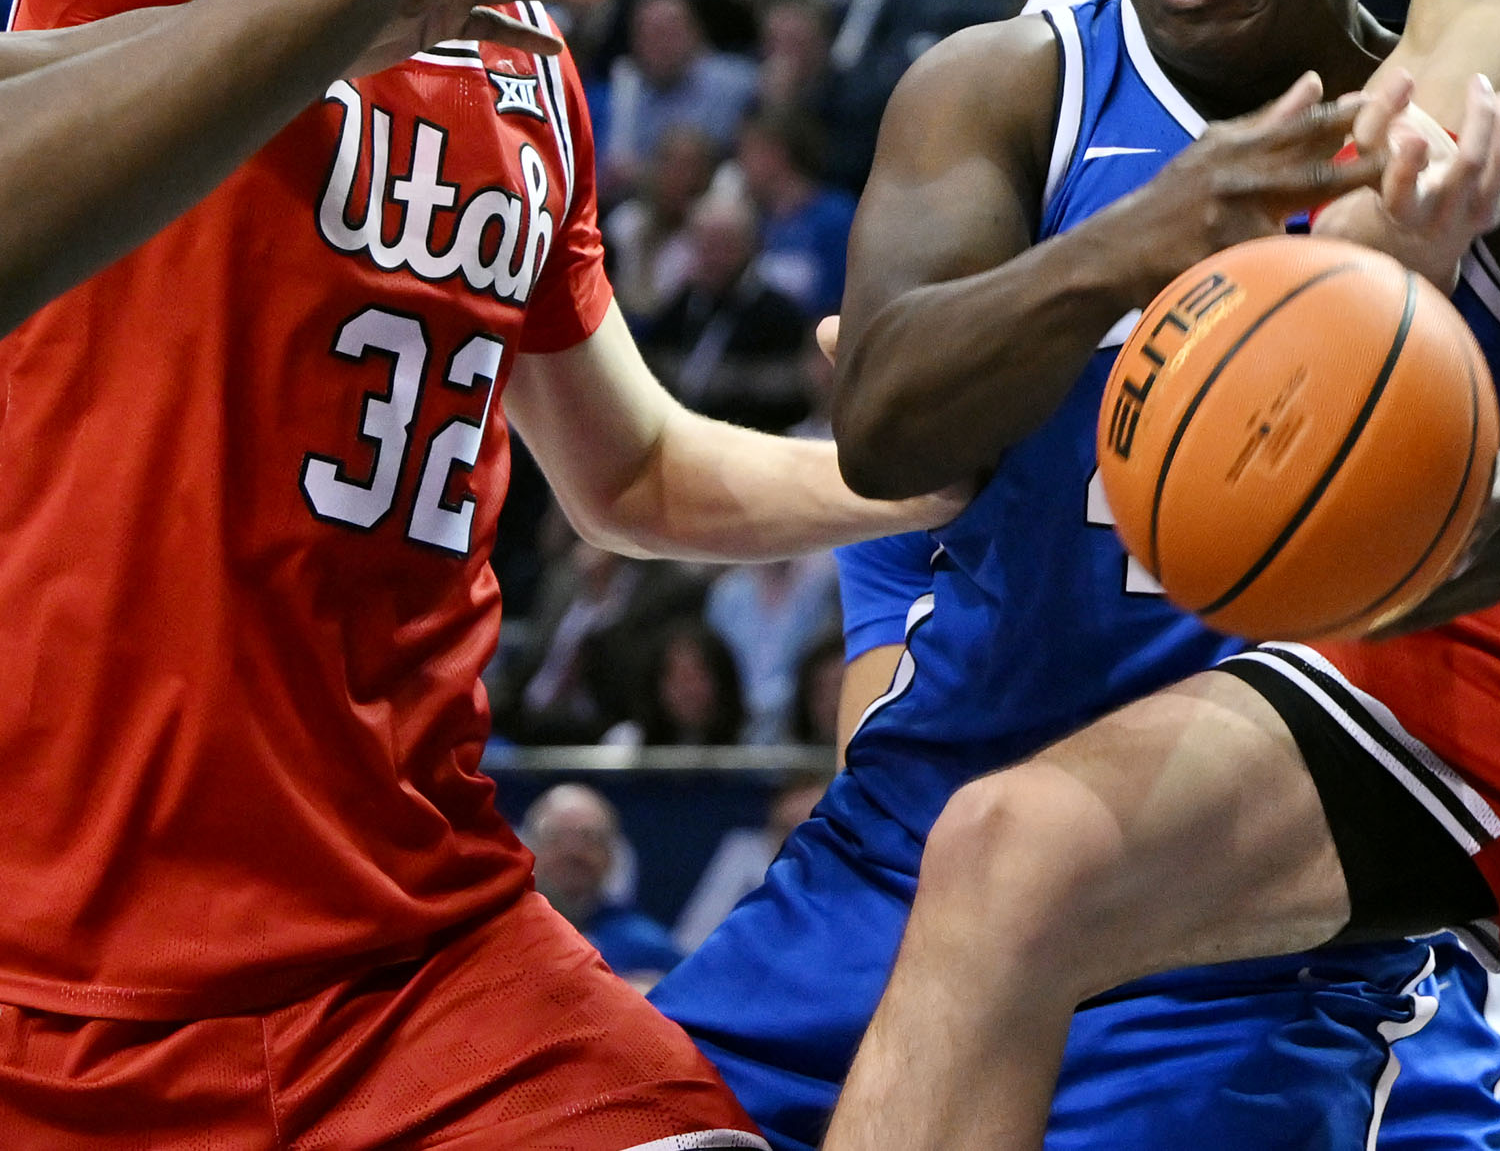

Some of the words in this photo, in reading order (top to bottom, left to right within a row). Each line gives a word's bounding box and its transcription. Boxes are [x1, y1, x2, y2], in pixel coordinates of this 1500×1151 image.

[314, 77, 553, 311] Utah
[486, 69, 547, 123] XII
[300, 303, 505, 558] 32
[1107, 273, 1237, 461] ELITE
